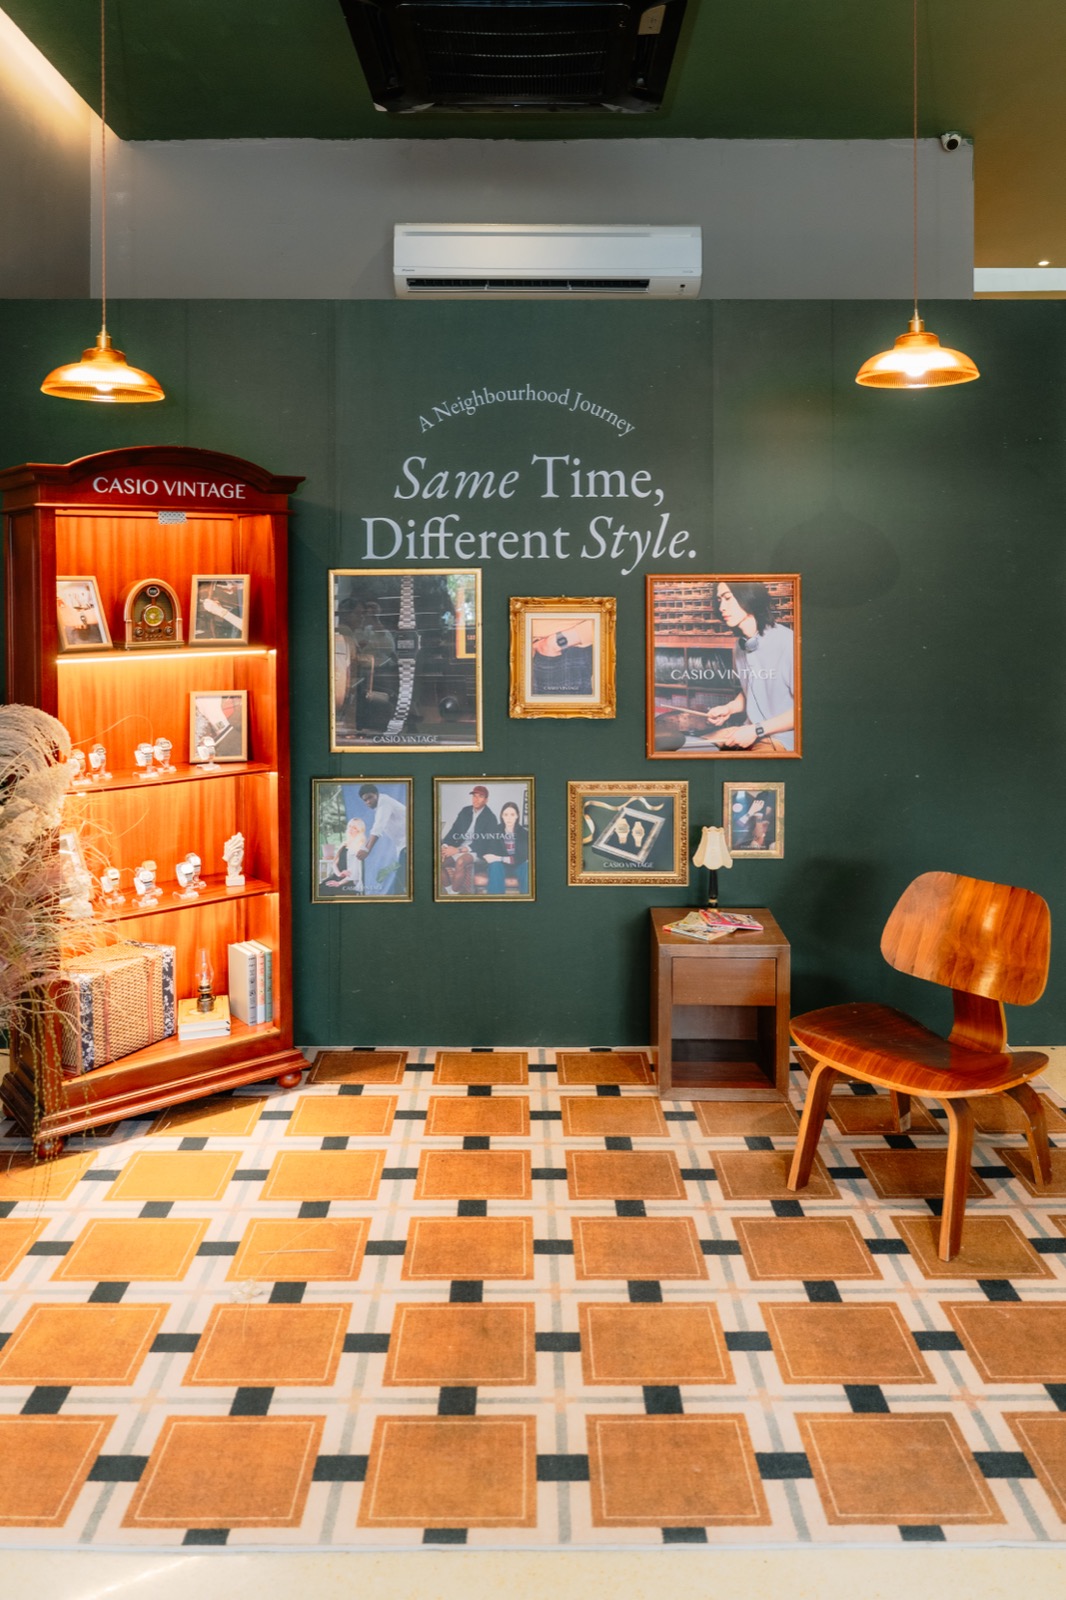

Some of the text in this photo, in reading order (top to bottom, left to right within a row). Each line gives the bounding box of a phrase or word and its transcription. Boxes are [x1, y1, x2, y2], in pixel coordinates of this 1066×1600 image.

[418, 384, 635, 437] A Neighbourhood Journey
[93, 476, 246, 499] CASIO VINTAGE
[394, 454, 664, 507] Same Time,
[360, 513, 696, 575] Different Style.
[670, 669, 776, 680] CASIO VINTAGE
[373, 735, 438, 743] CASIO VINTAGE
[452, 832, 517, 840] CASIO VINTAGE
